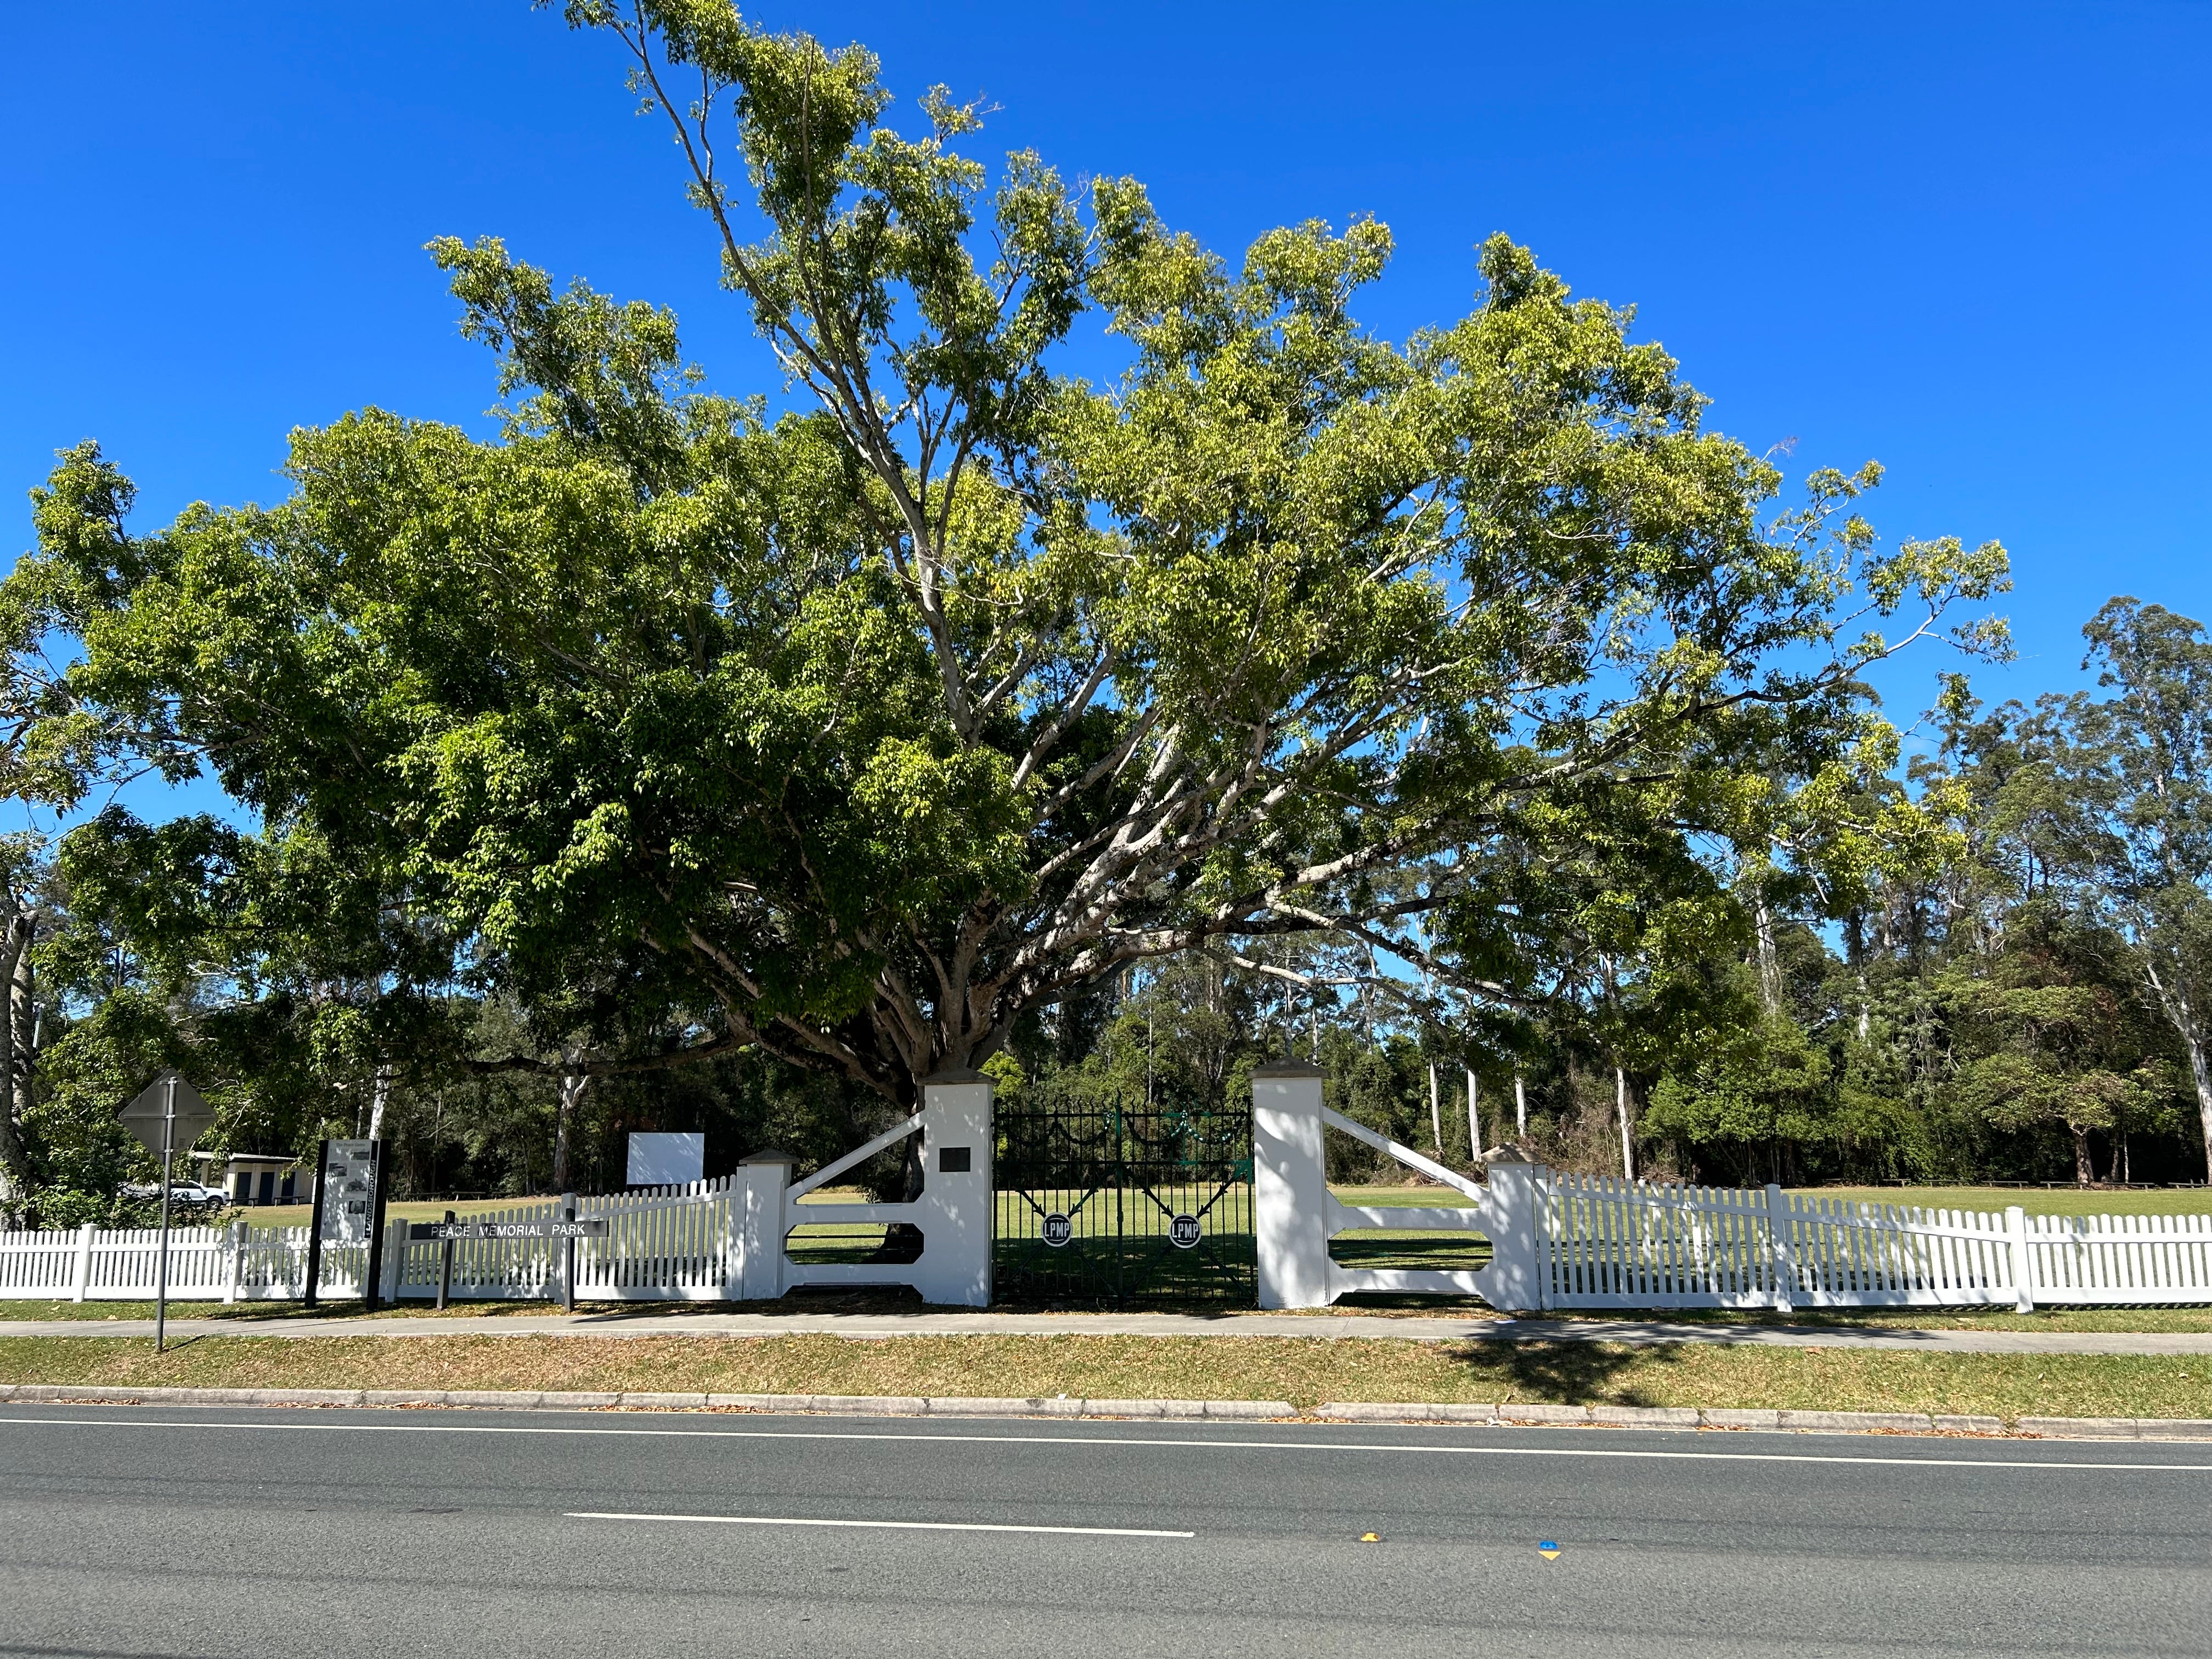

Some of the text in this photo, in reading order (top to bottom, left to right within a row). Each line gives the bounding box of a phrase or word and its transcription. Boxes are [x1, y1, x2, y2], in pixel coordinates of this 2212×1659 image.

[365, 1160, 376, 1231] LANDSBOROUGH
[431, 1224, 585, 1237] PEACE MEMORIAL PARK
[1044, 1222, 1070, 1238] LPMP
[1172, 1223, 1199, 1238] LPMP
